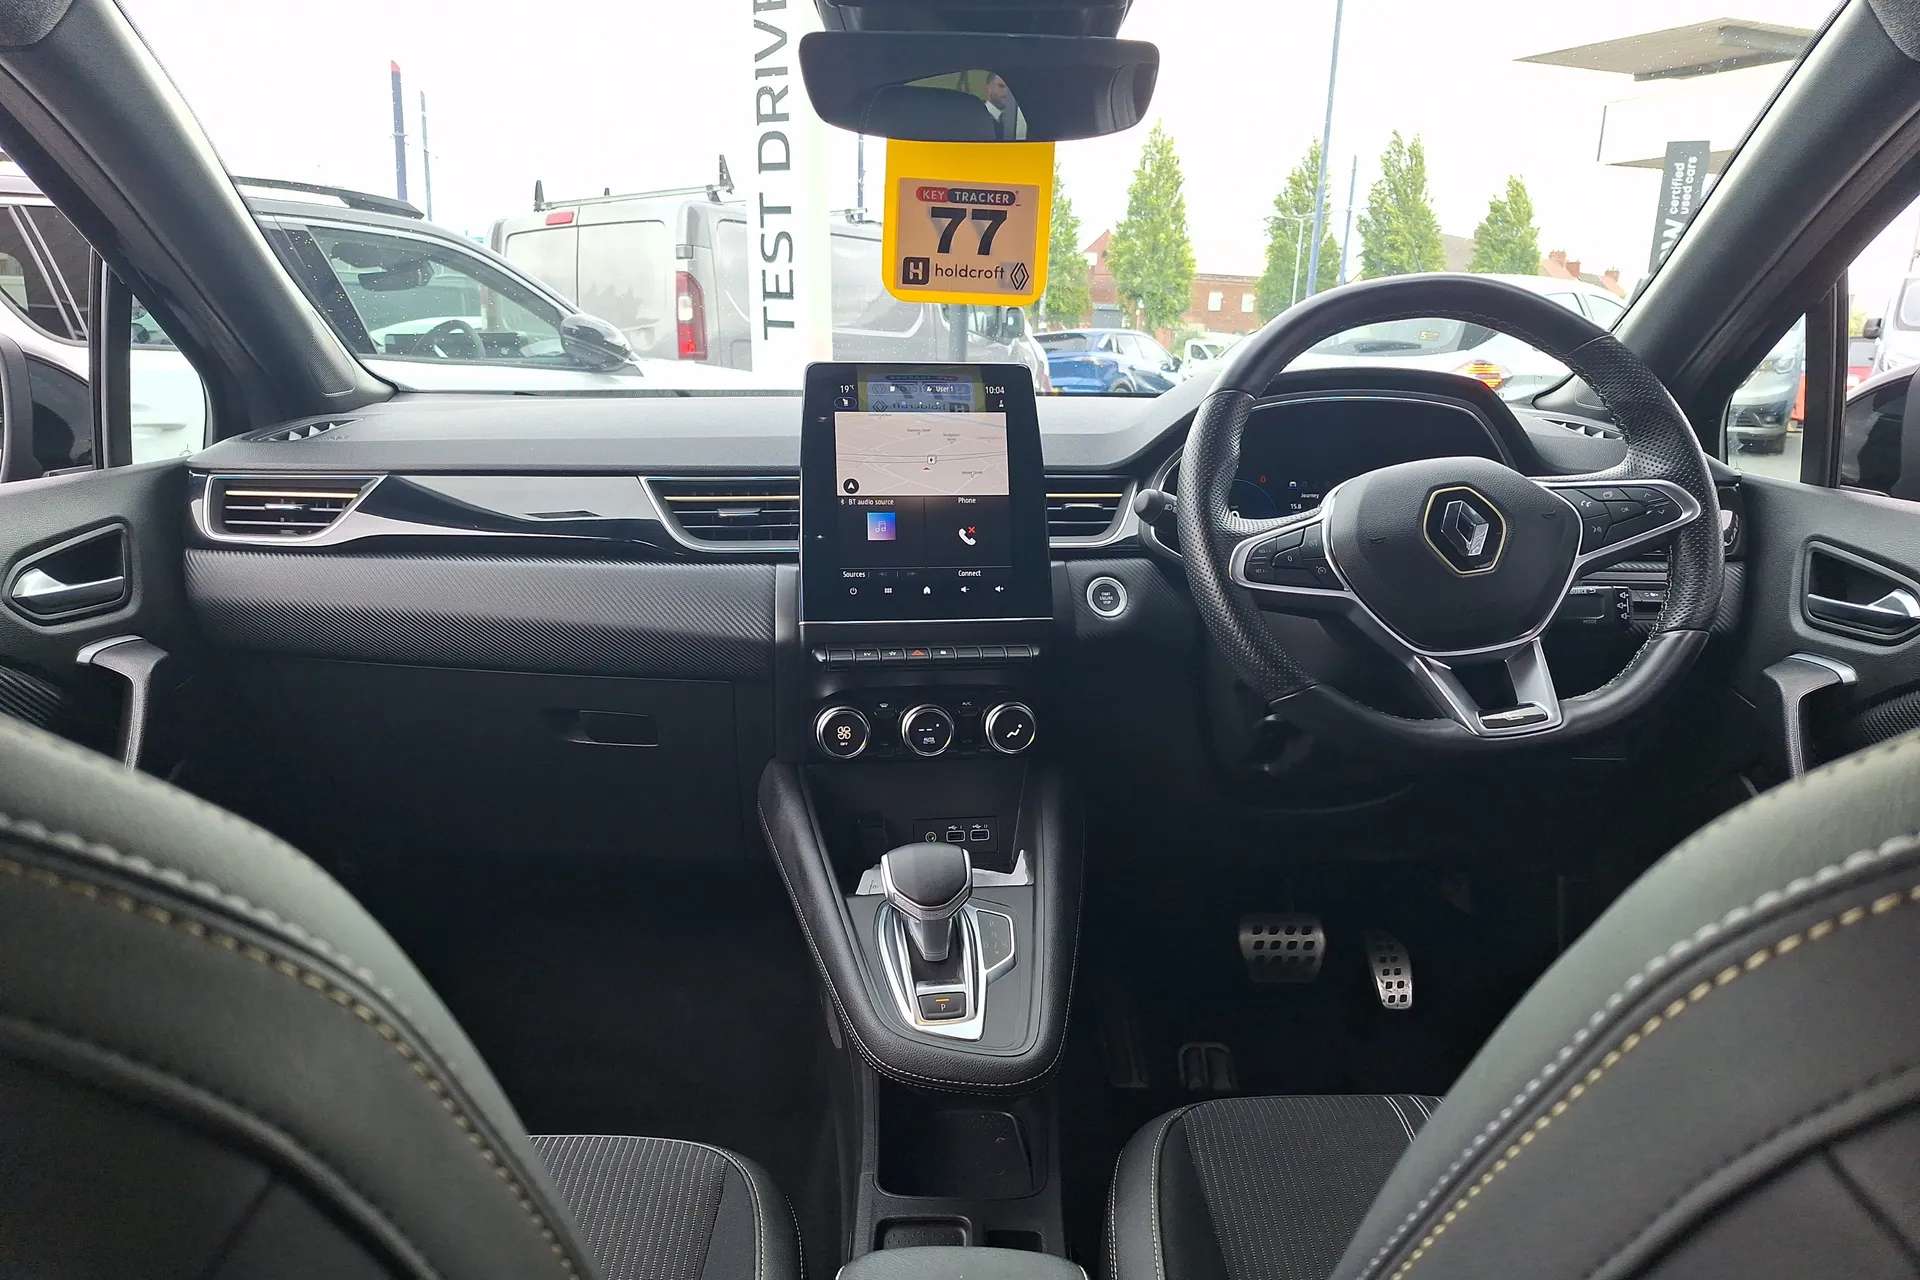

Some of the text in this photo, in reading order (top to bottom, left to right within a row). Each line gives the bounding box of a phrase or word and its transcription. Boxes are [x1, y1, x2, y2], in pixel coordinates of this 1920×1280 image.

[1669, 162, 1686, 215] certified
[1680, 155, 1699, 215] used cars
[921, 189, 1010, 205] KEY TRACKER
[930, 206, 1008, 256] 77
[758, 191, 795, 341] TEST
[935, 263, 1005, 280] holdcroft
[984, 386, 1005, 394] 10:04
[957, 496, 977, 504] Phone
[957, 569, 981, 577] Connect
